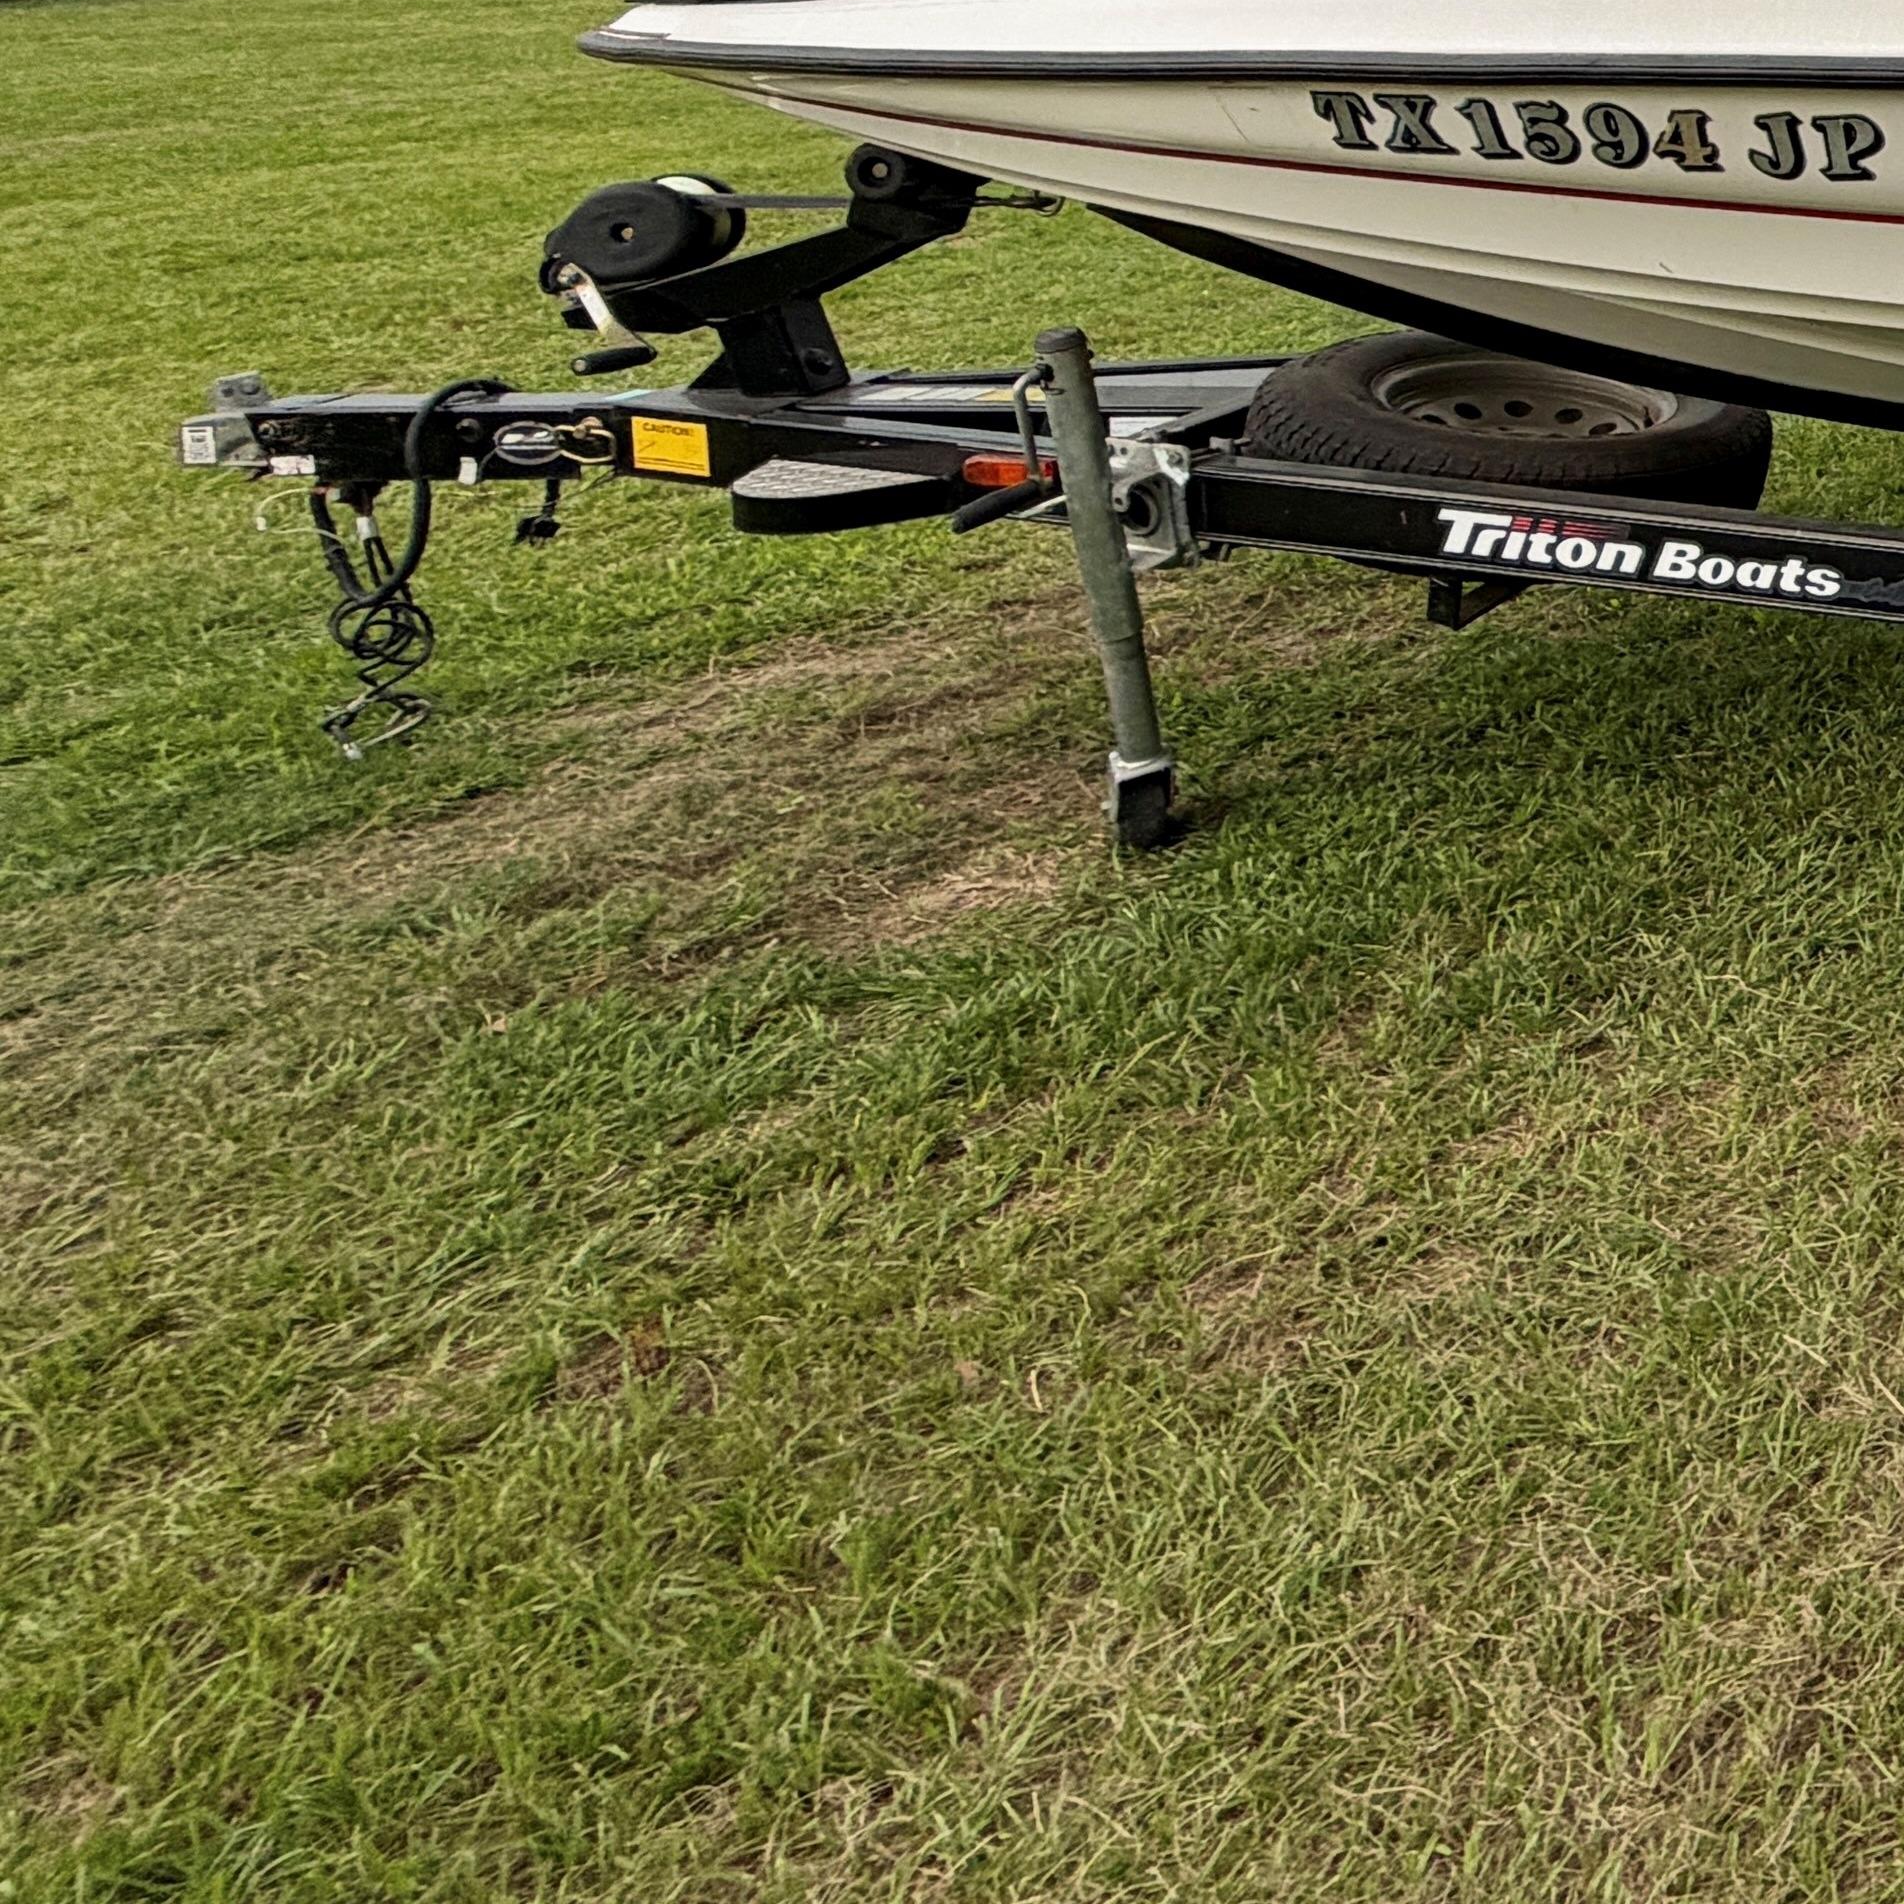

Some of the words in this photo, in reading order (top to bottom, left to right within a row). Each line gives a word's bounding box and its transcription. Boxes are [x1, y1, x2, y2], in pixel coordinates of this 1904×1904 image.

[1747, 111, 1886, 181] JP
[1437, 508, 1643, 575] Triton
[1652, 541, 1843, 596] Boats
